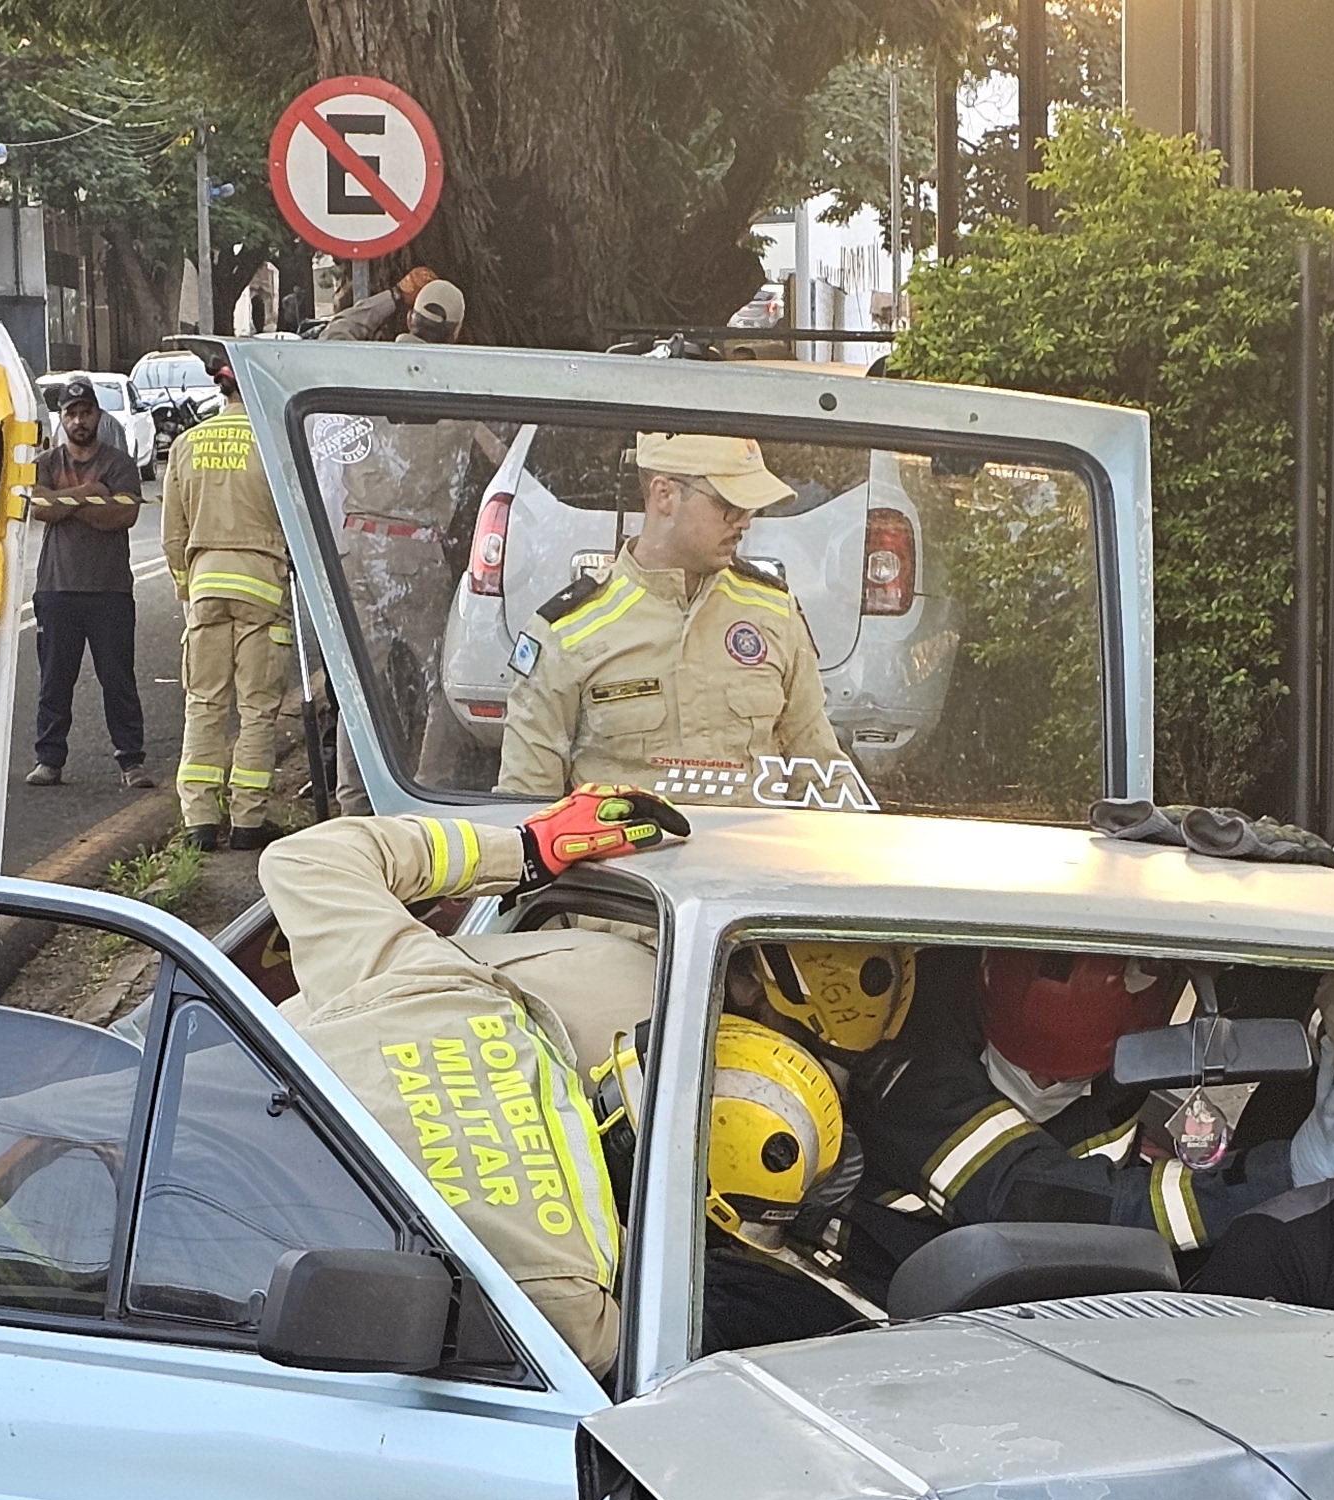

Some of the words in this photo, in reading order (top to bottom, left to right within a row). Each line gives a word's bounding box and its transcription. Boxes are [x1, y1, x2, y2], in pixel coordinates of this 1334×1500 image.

[326, 113, 385, 215] E
[192, 441, 250, 455] MILITAR
[192, 455, 247, 471] PARANÁ
[431, 1038, 519, 1206] MILITAR
[467, 1015, 573, 1235] BOMBEIRO
